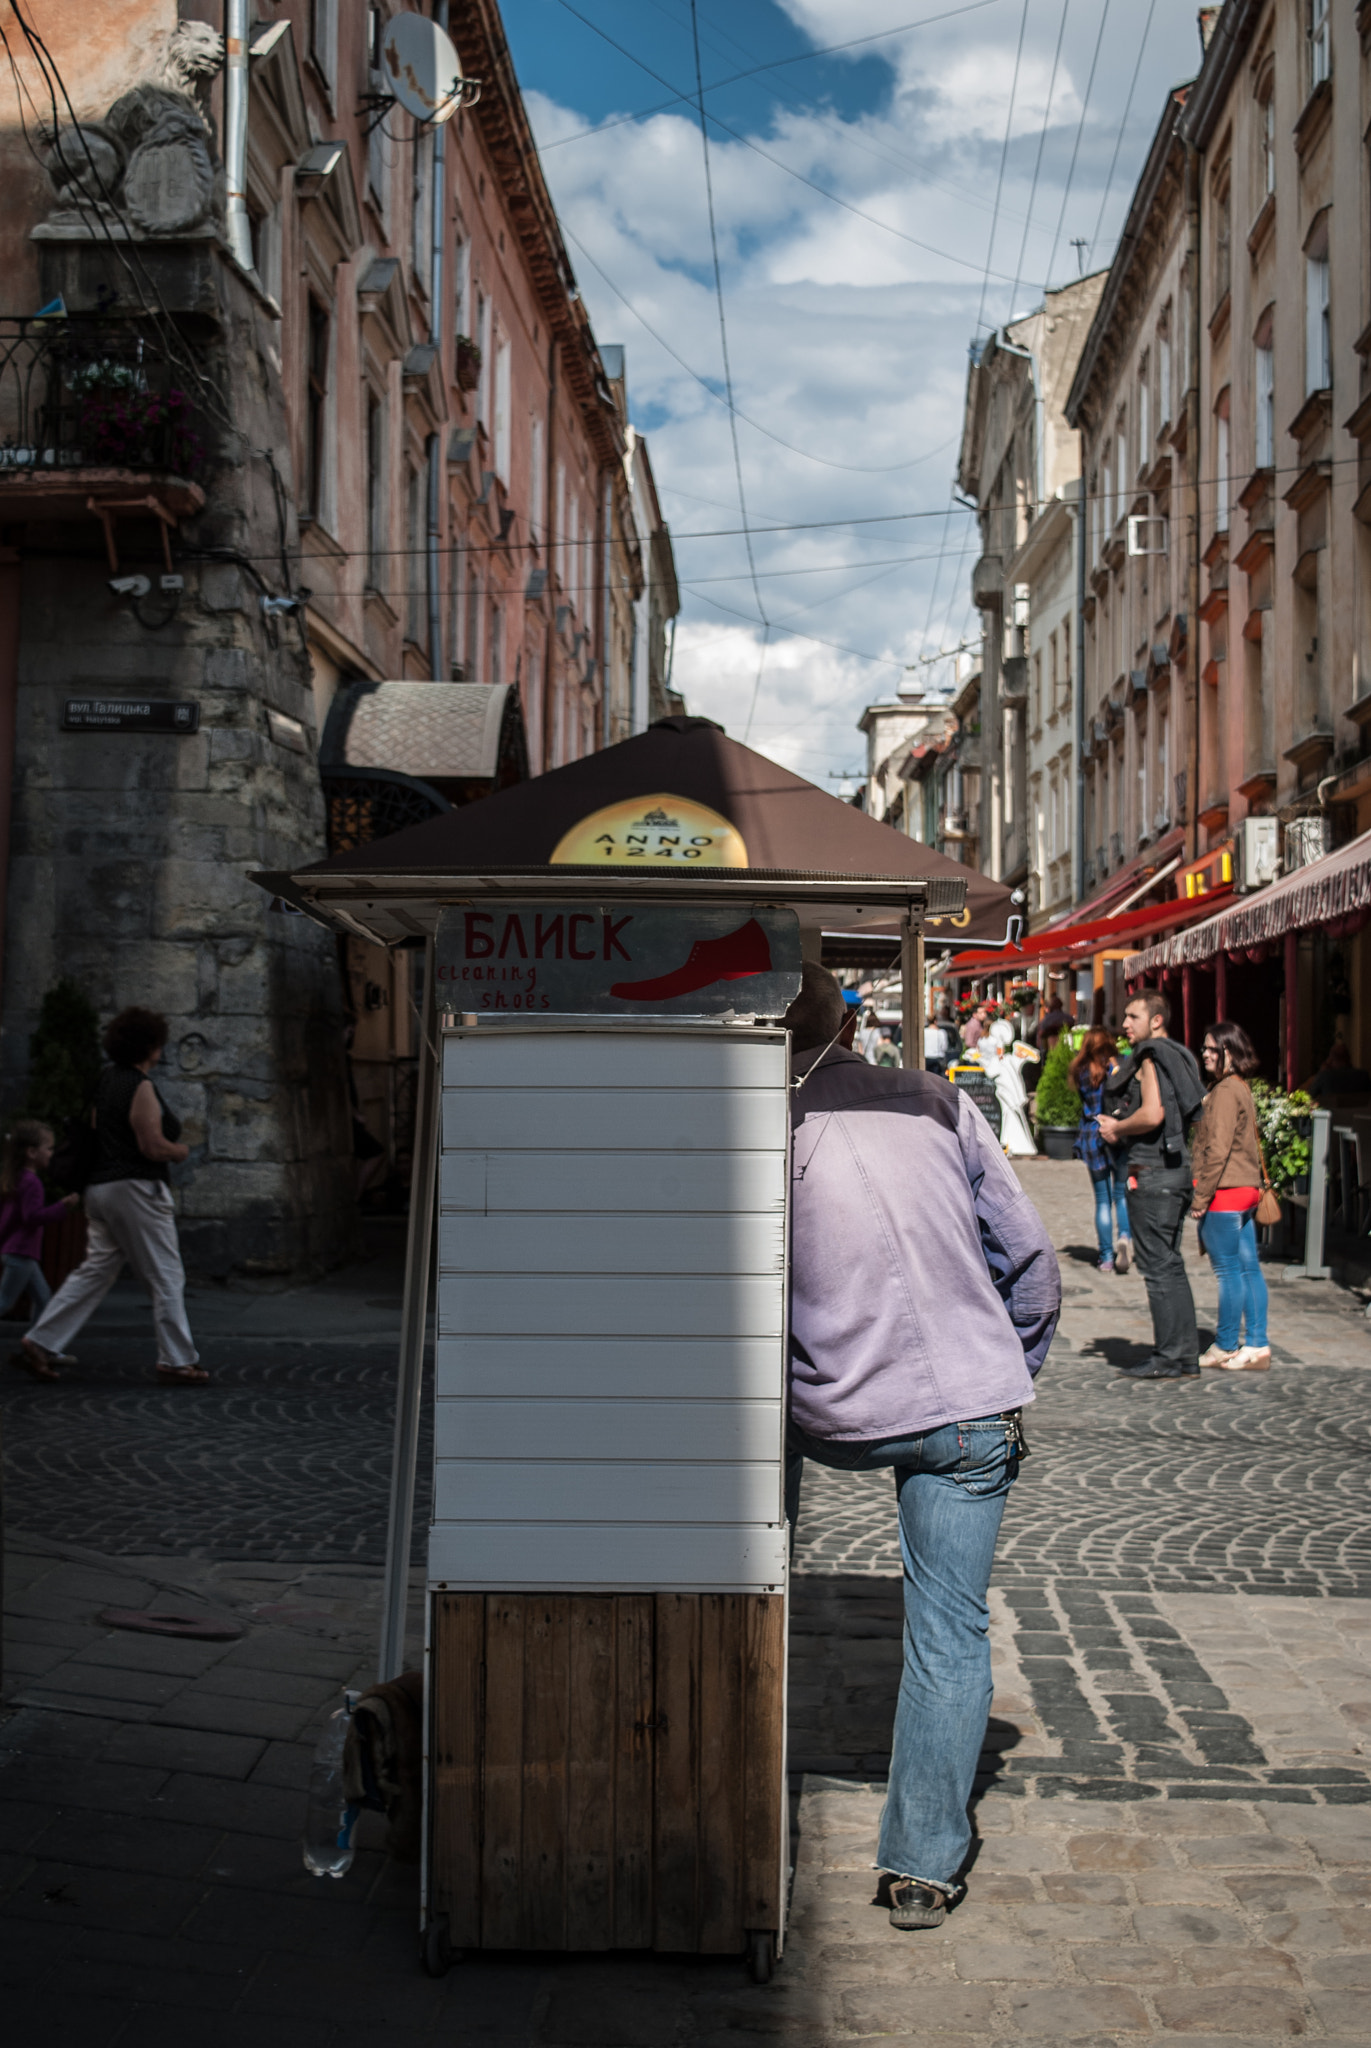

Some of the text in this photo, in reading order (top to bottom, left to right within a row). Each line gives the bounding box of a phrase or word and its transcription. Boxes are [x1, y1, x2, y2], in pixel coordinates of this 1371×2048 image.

[70, 702, 151, 716] вул. Галицька
[594, 834, 713, 847] ANNO
[605, 847, 702, 858] 1240
[464, 912, 635, 962] БЛИСК
[437, 965, 537, 993] cleaning
[480, 990, 551, 1009] shoes
